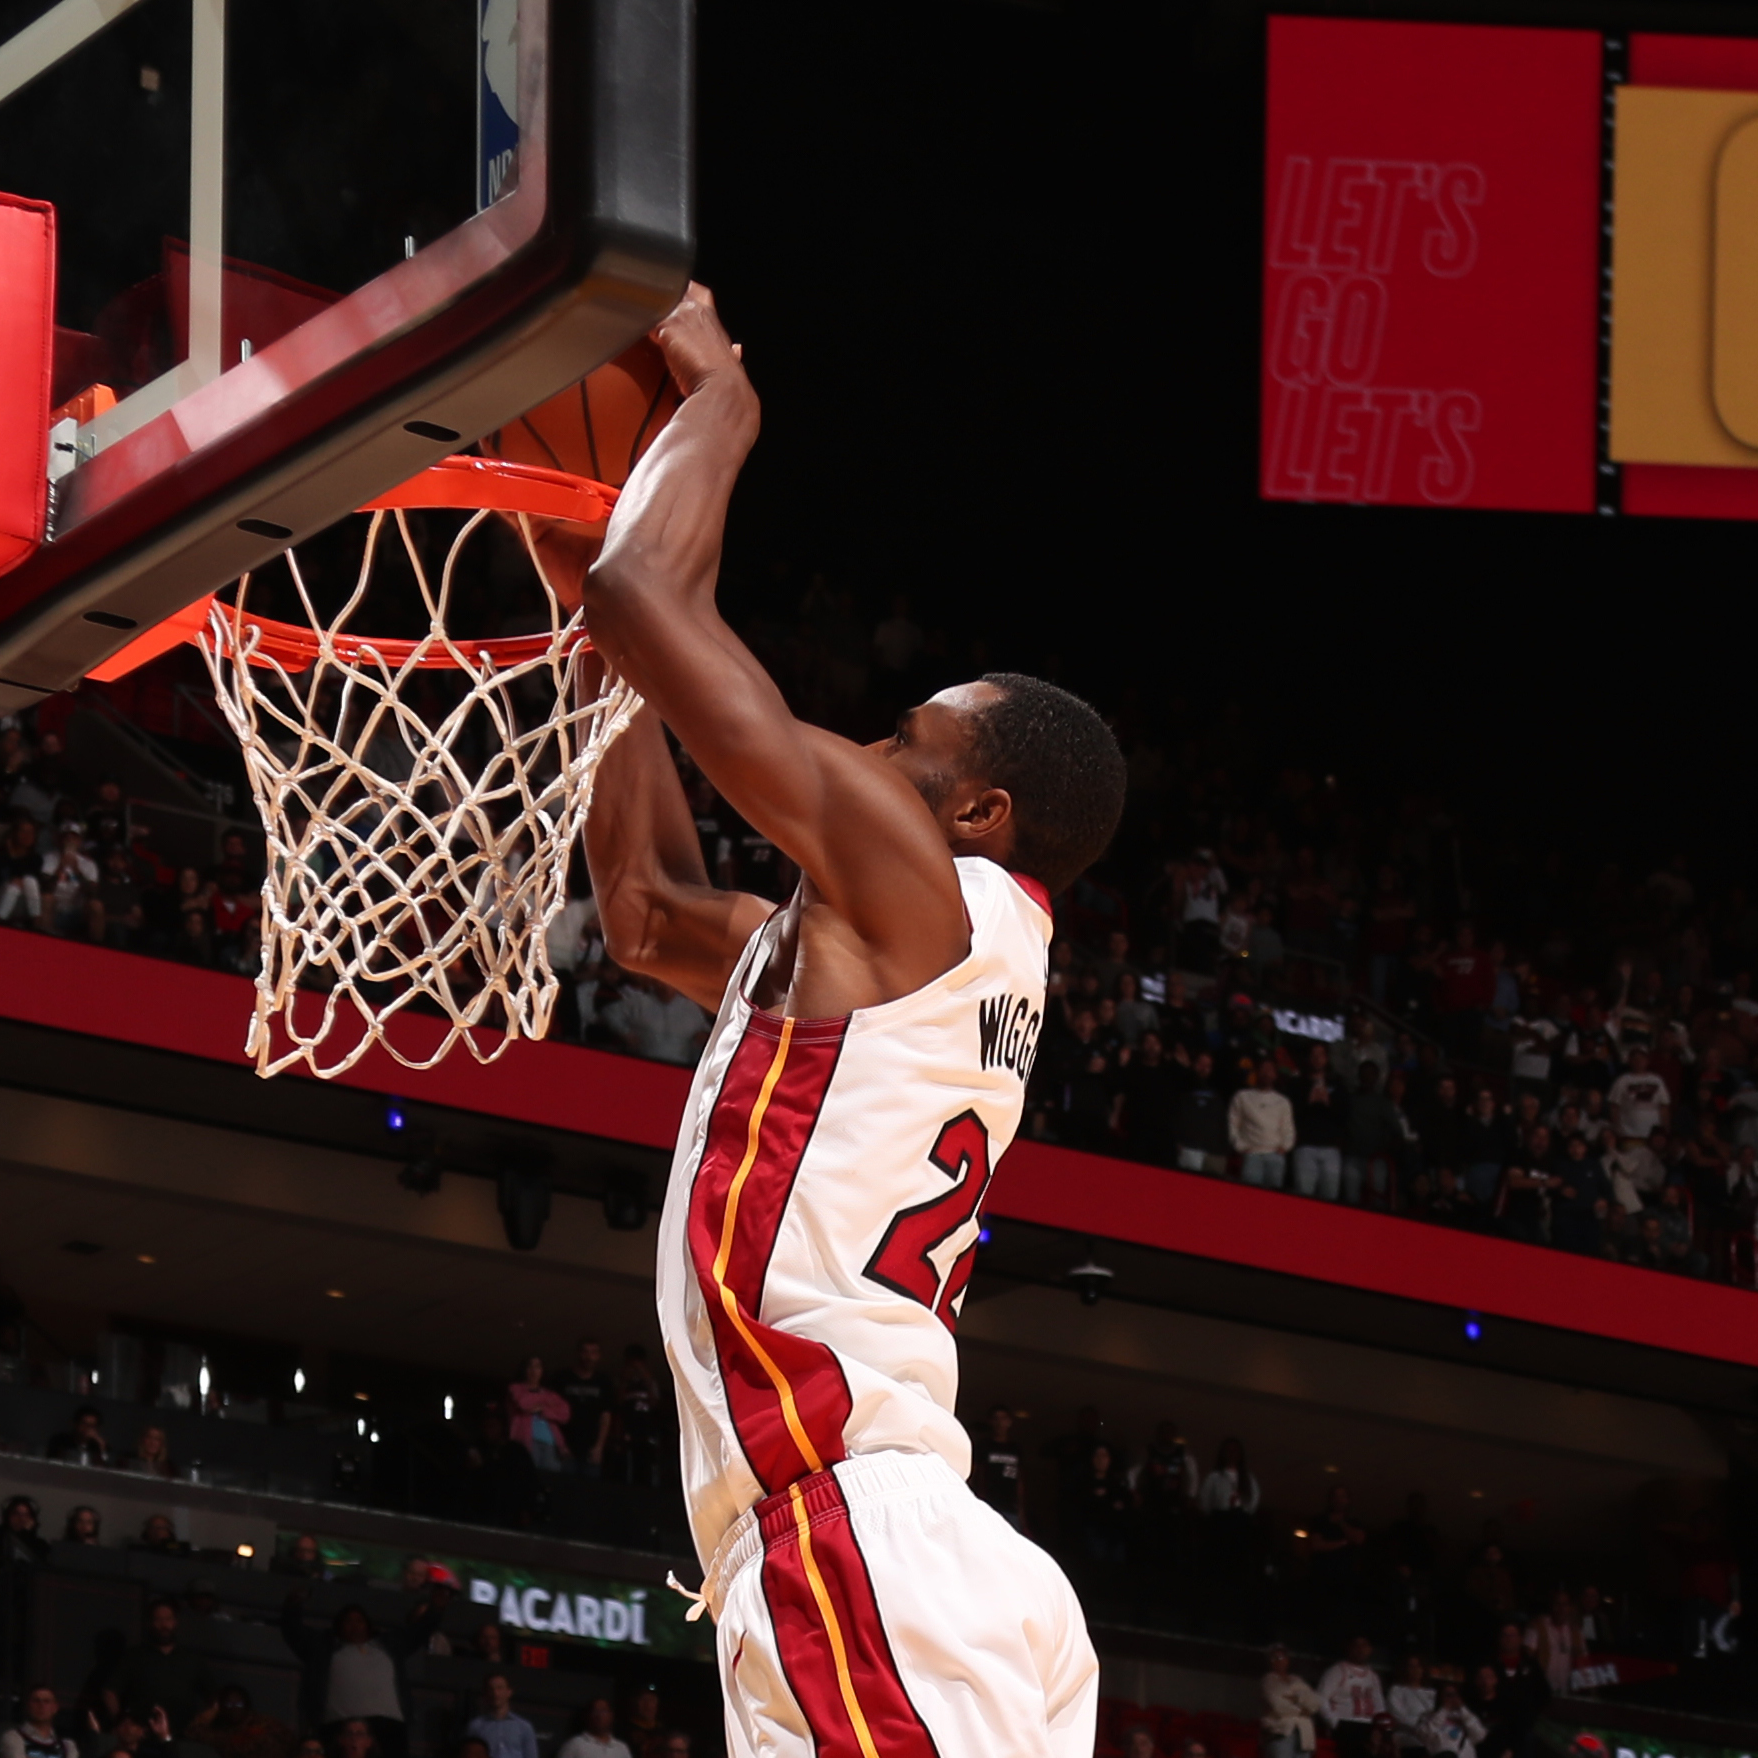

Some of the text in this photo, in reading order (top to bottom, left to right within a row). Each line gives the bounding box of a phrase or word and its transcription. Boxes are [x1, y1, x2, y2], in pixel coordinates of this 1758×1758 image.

[1269, 154, 1485, 279] LET'S
[1269, 274, 1388, 386] GO
[1264, 386, 1483, 504] LET'S
[980, 993, 1040, 1085] WIGG
